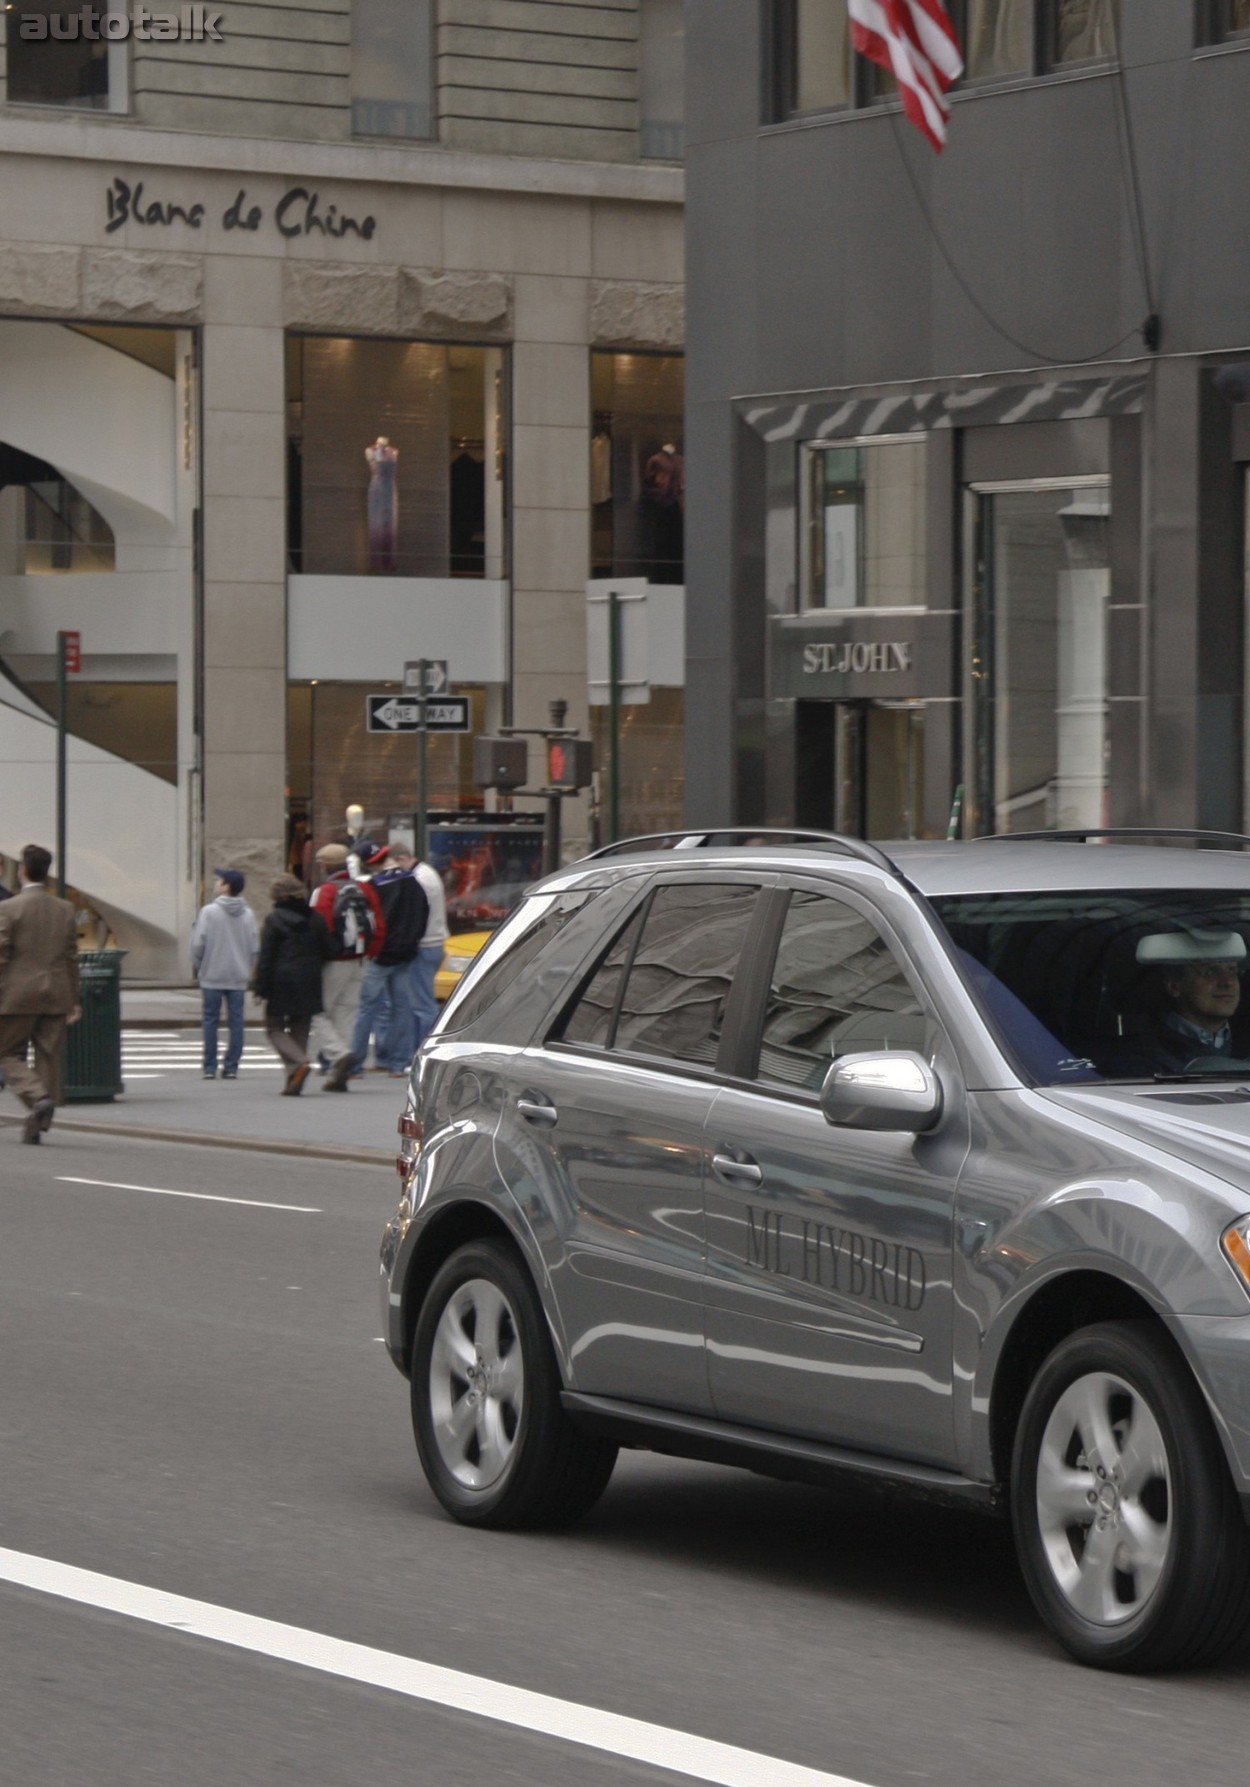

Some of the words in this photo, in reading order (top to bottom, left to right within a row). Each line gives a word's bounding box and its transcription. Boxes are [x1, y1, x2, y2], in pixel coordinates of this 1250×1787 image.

[105, 177, 205, 232] Blanc
[223, 190, 262, 231] de
[275, 187, 376, 240] Chine
[383, 707, 412, 721] ONE
[426, 707, 457, 720] WAY
[745, 1205, 791, 1276] ML
[801, 1220, 927, 1312] HYBRID
